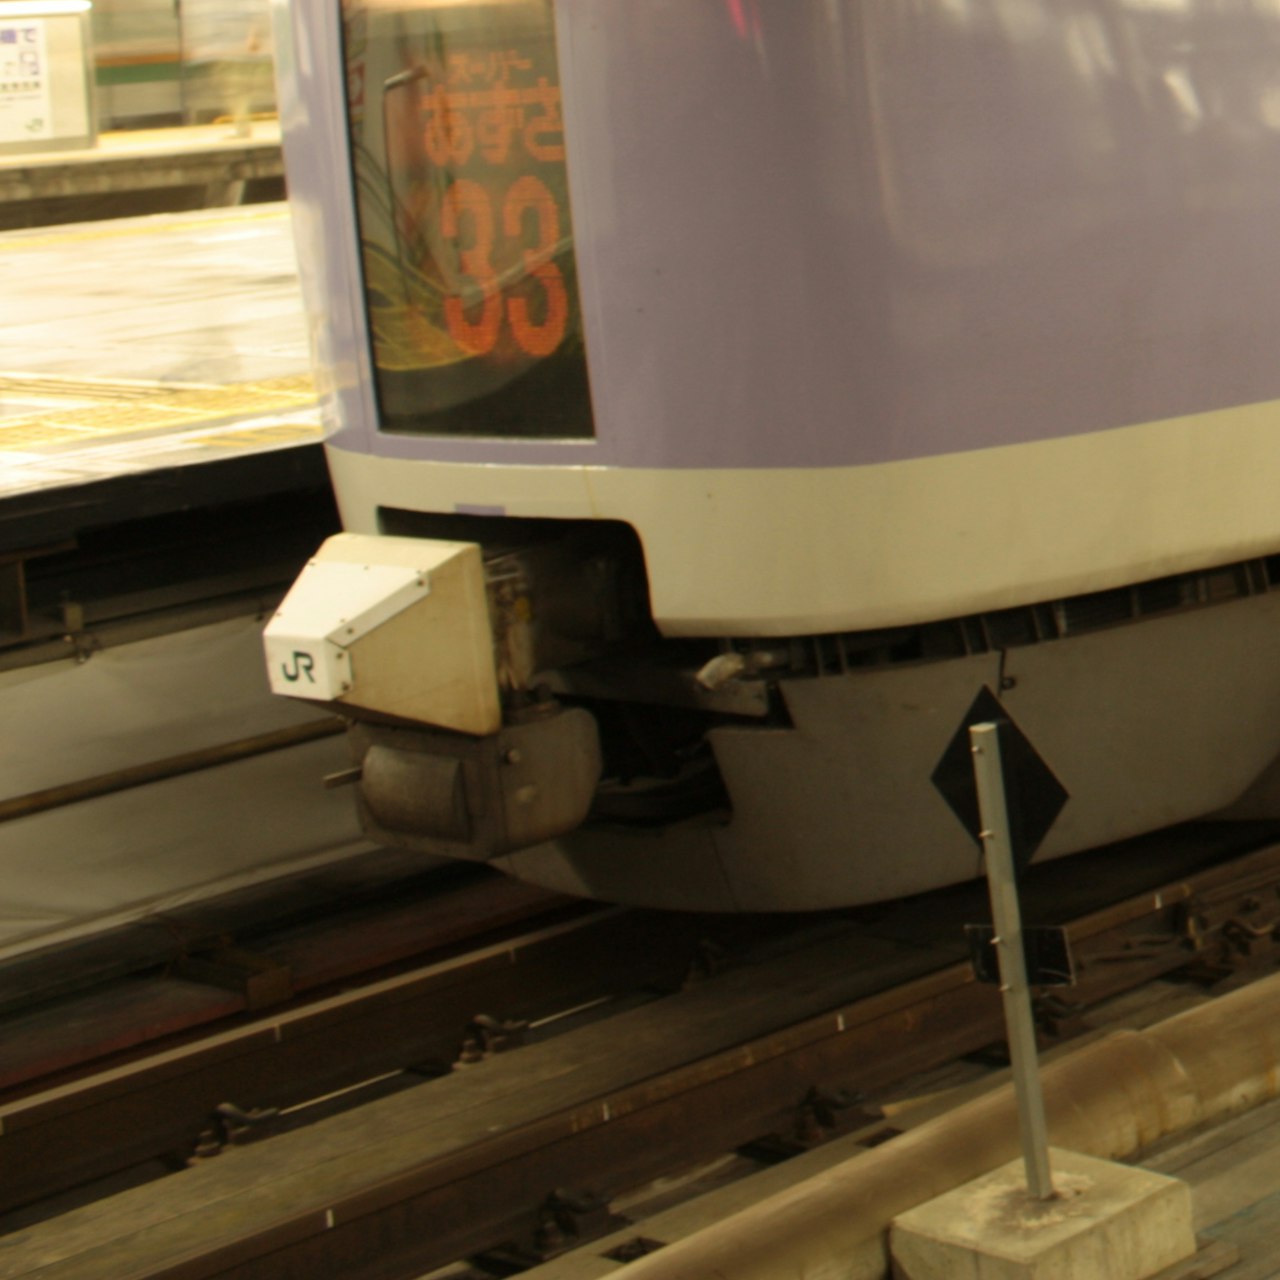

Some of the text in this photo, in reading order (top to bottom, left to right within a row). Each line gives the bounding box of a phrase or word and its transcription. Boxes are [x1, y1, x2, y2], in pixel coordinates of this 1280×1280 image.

[447, 49, 533, 84] スーパー
[421, 76, 566, 167] あずさ
[441, 175, 569, 358] 33
[281, 650, 317, 684] JR
